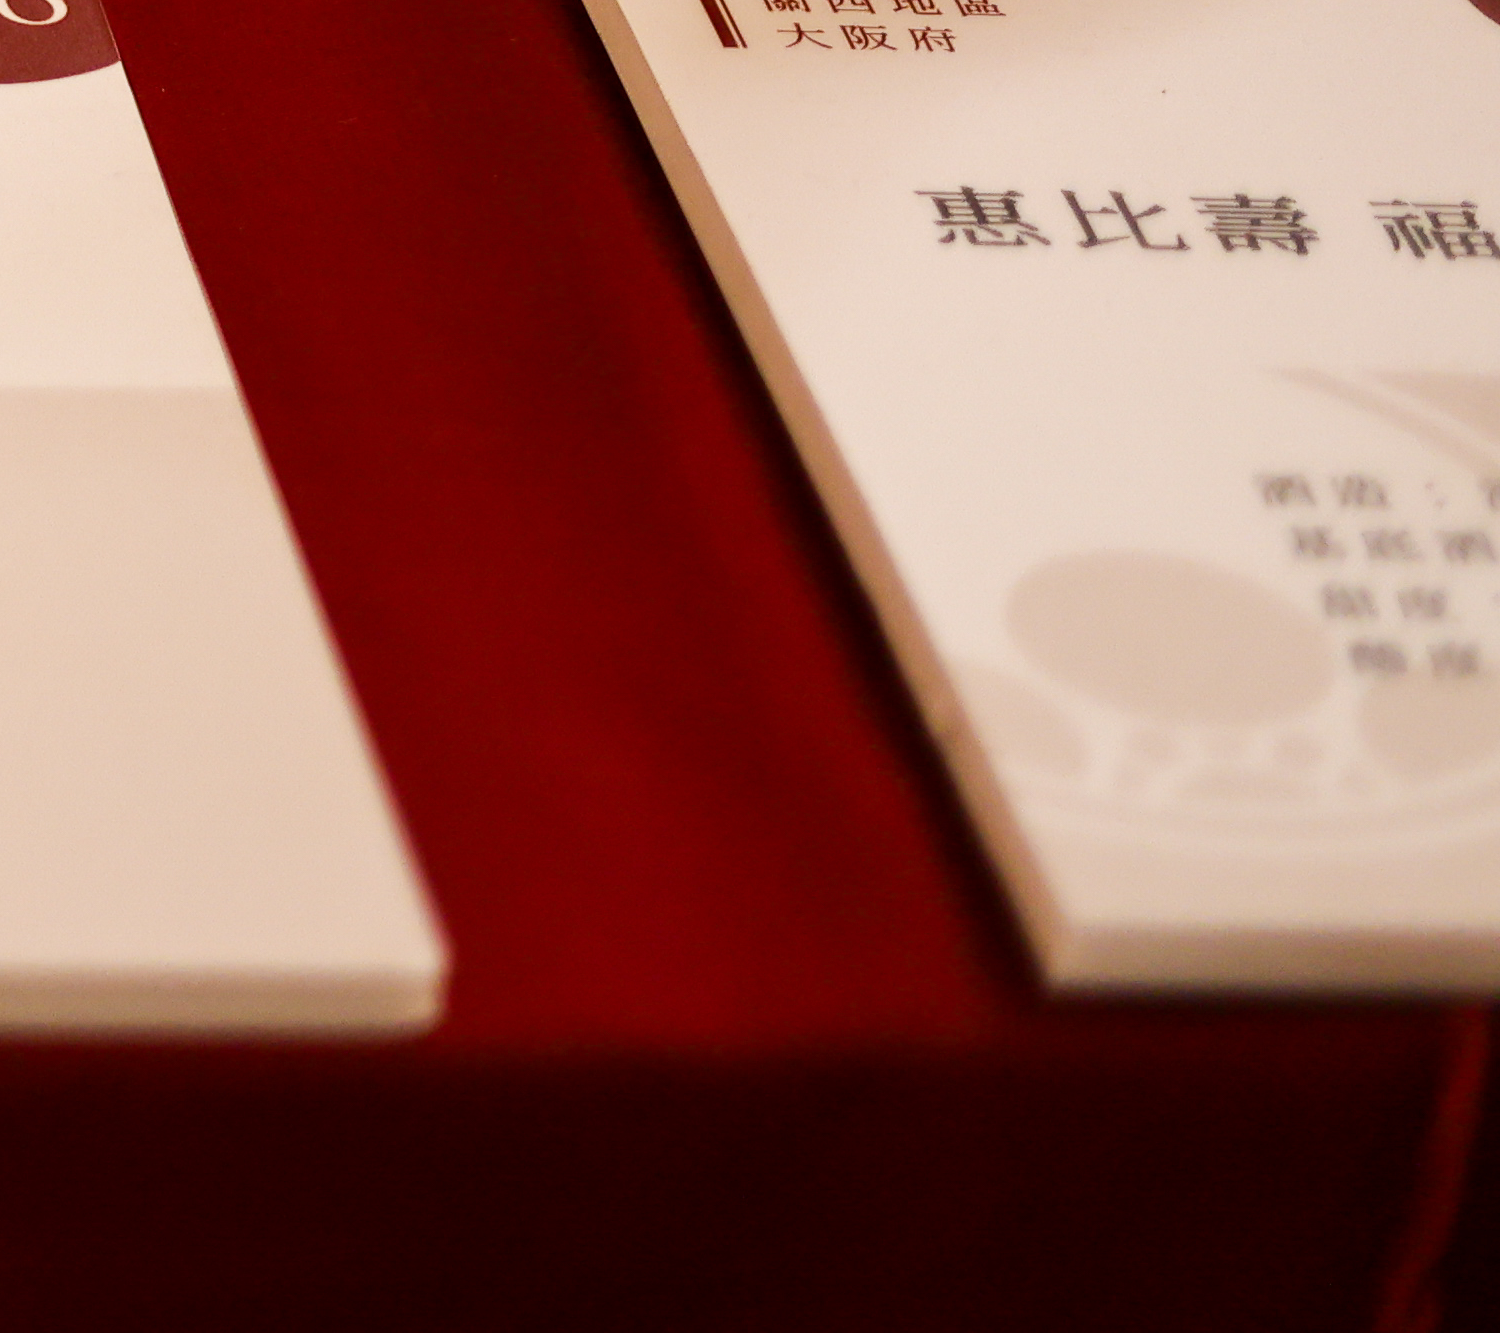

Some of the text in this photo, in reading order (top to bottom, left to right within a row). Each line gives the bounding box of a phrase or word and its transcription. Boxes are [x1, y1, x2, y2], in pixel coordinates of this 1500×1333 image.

[776, 22, 959, 54] 大阪府
[916, 184, 1500, 261] 惠比壽 福
